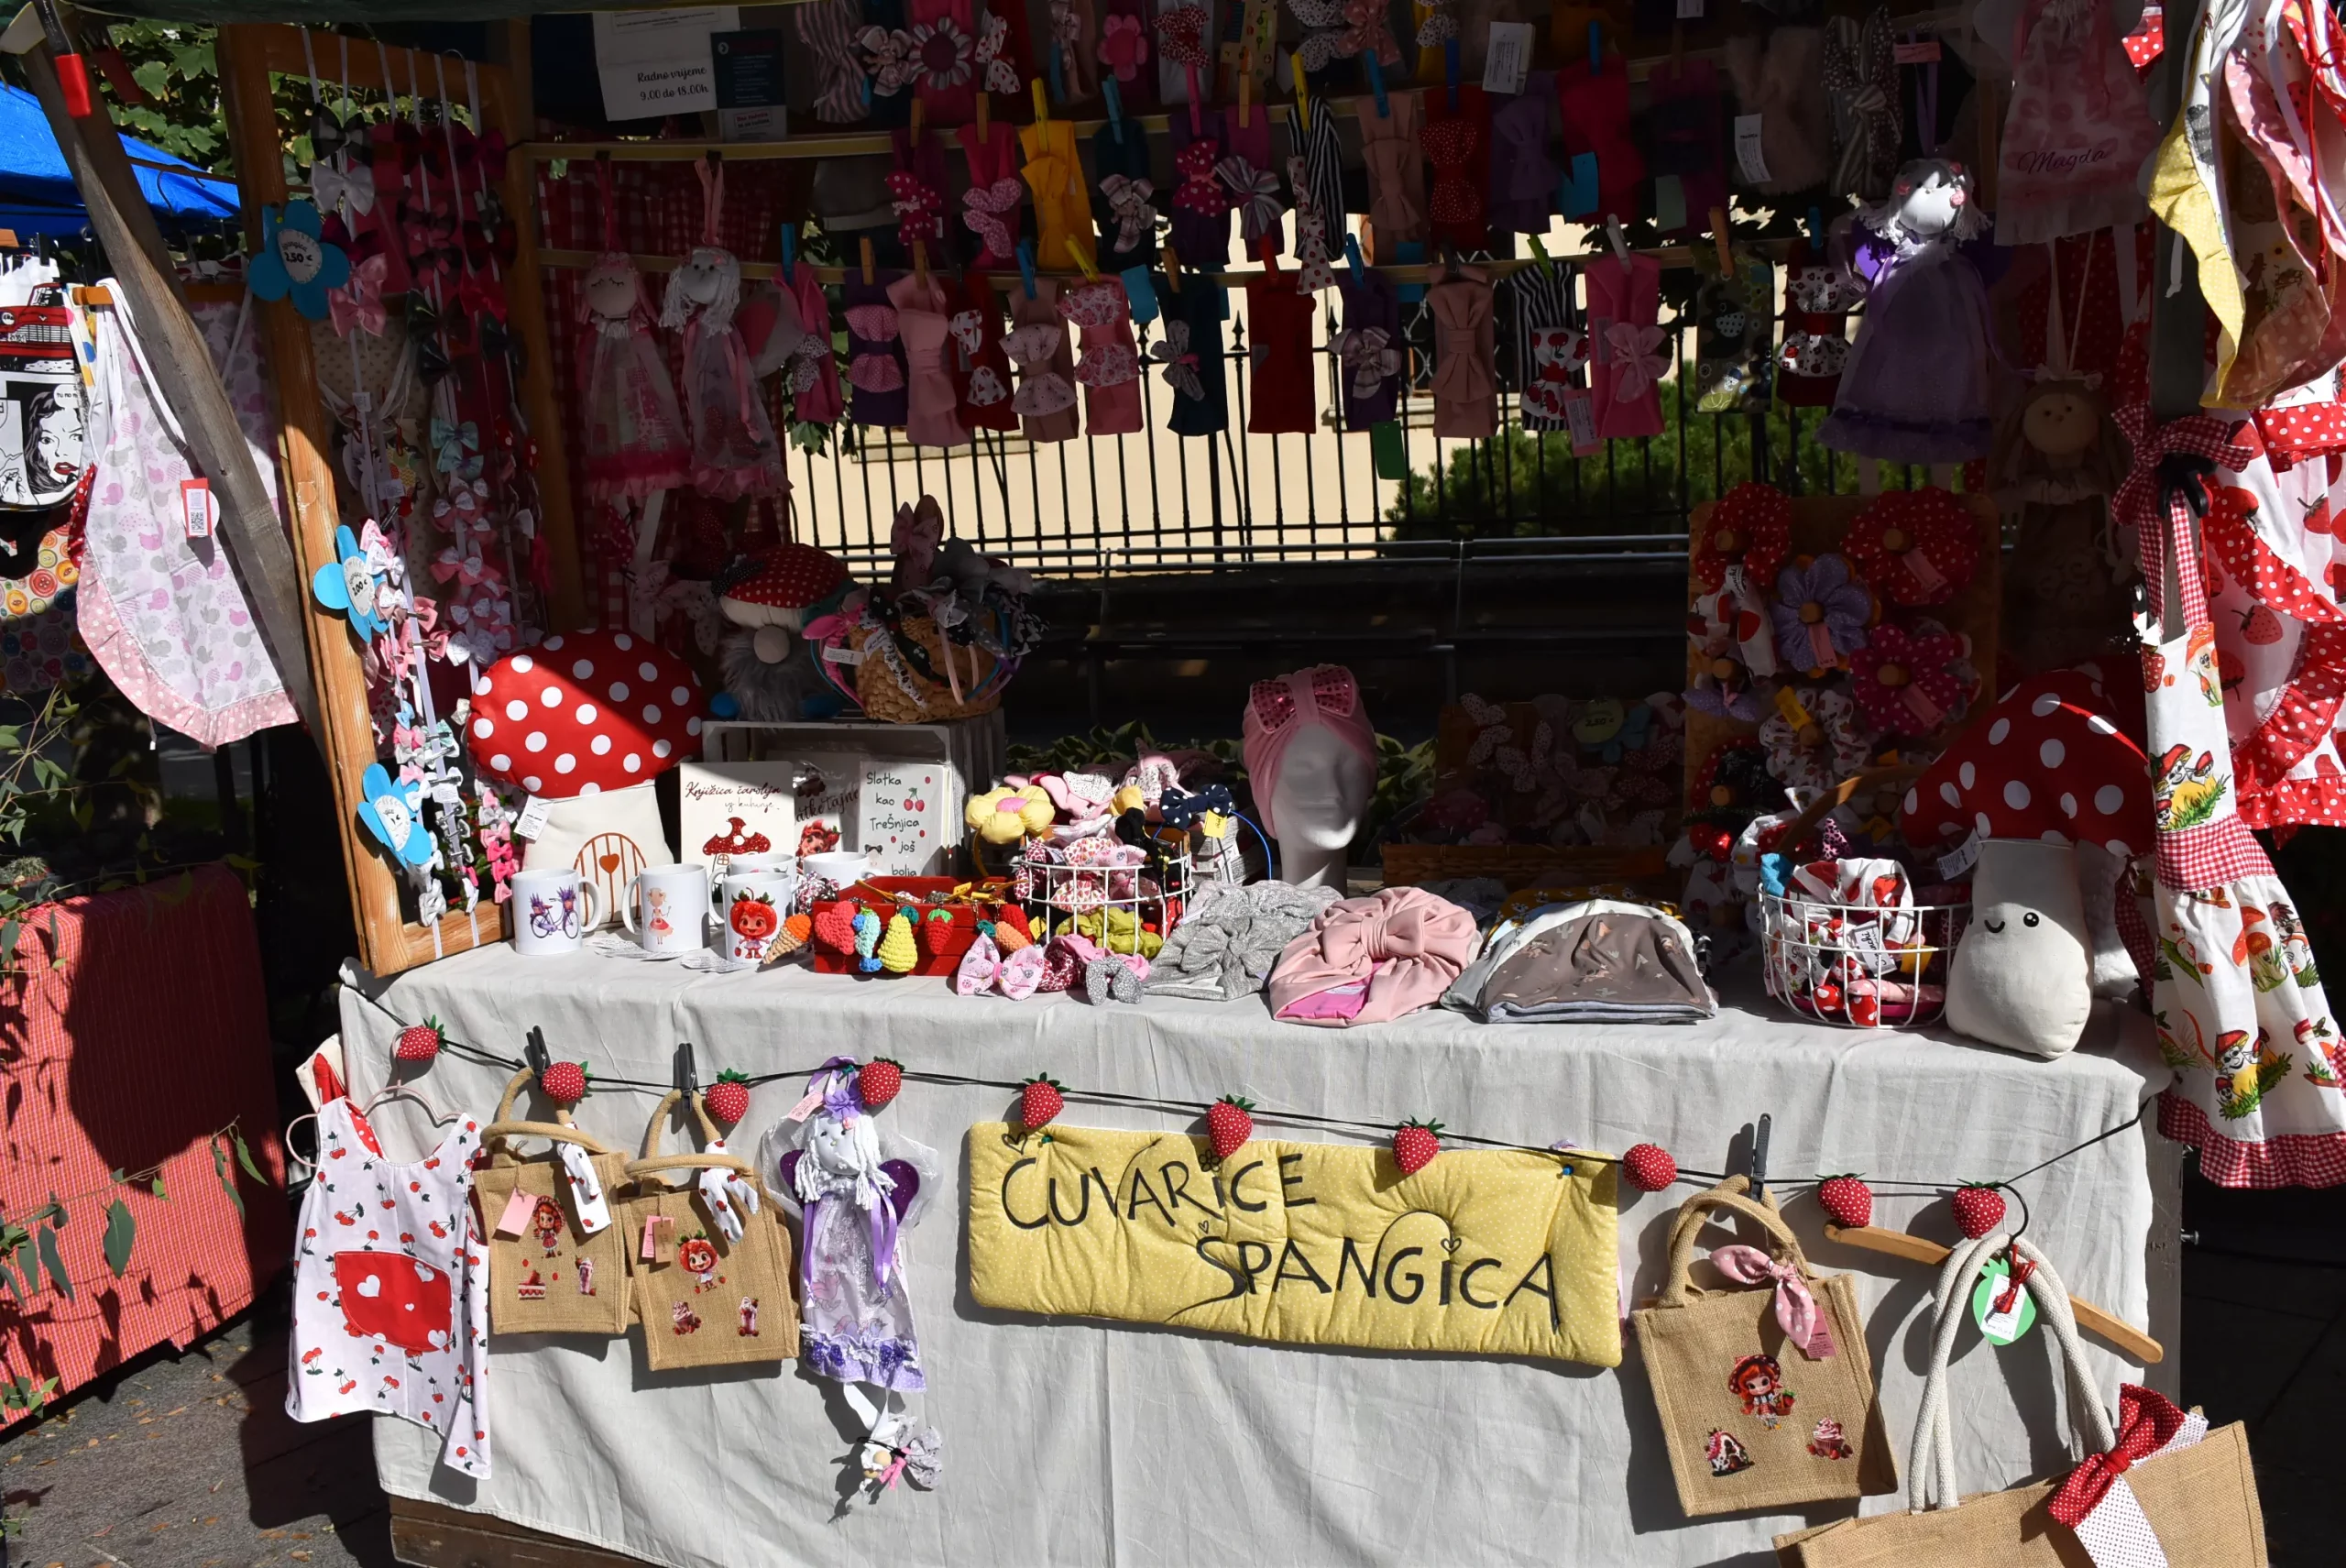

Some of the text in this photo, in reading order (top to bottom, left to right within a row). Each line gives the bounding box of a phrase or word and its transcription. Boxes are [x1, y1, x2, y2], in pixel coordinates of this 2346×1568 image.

[637, 66, 707, 83] Radno vrijeme
[640, 90, 661, 101] 9.00
[663, 87, 675, 98] do
[2017, 148, 2109, 174] Magda
[866, 772, 903, 786] Slatka
[685, 782, 782, 800] Knjižica čarolija
[875, 793, 895, 806] kao
[898, 840, 915, 854] još
